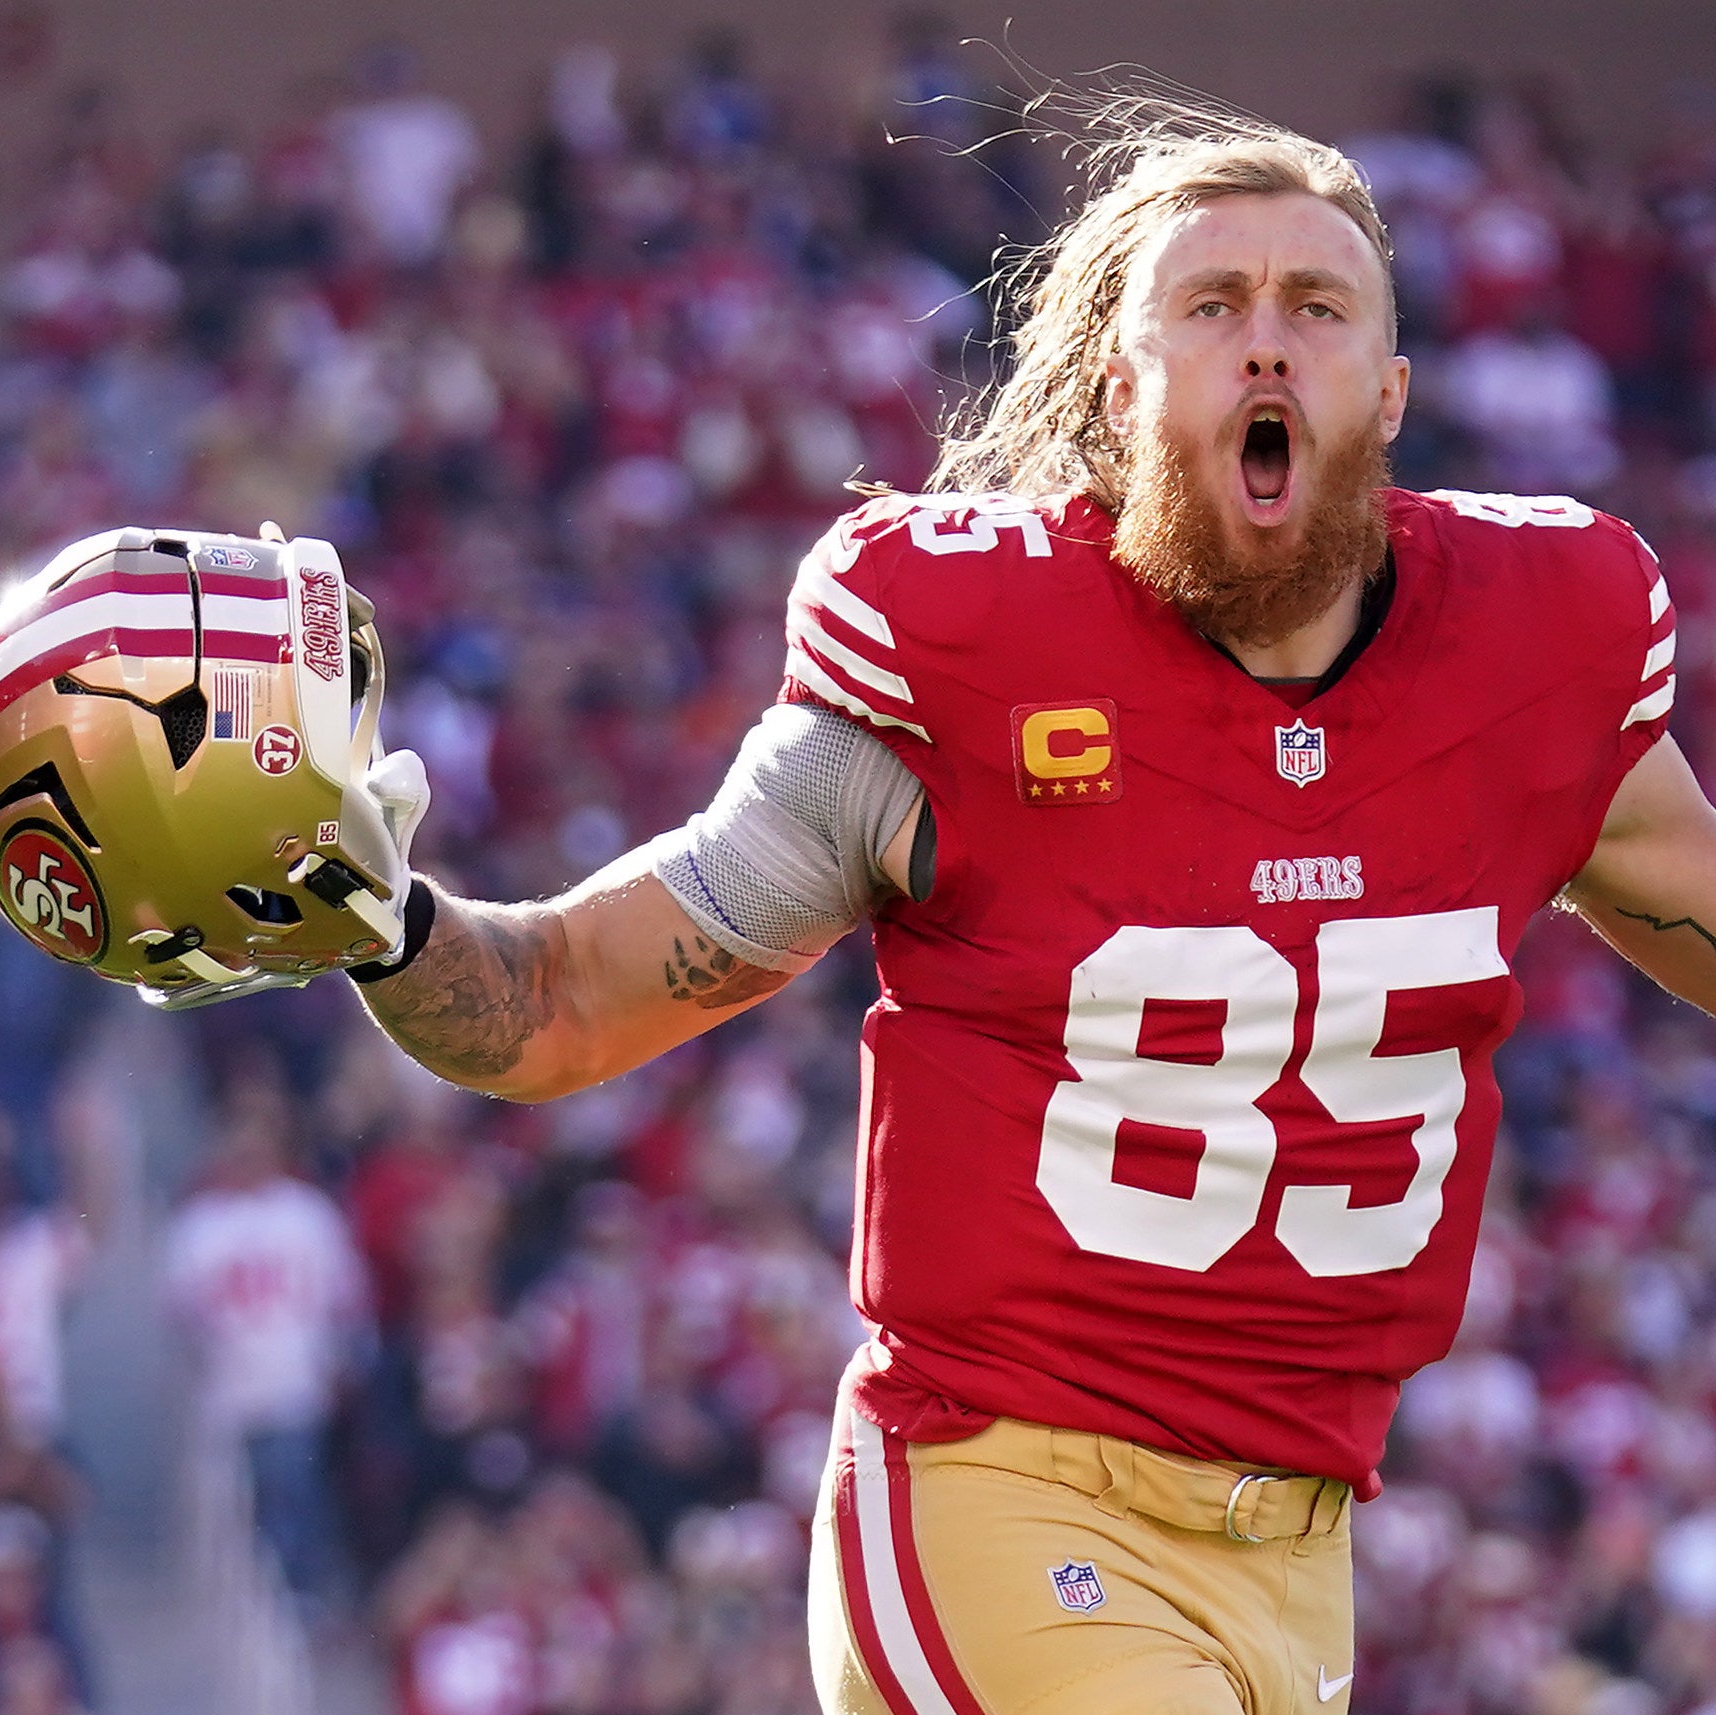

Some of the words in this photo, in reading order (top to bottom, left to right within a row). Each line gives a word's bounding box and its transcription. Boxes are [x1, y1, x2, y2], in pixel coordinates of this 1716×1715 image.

[299, 565, 344, 682] 49ERS
[262, 725, 296, 771] 37
[1021, 706, 1112, 780] C
[1282, 750, 1318, 774] NFL
[319, 823, 337, 842] 85
[7, 852, 95, 942] SF
[1248, 854, 1365, 904] 49ERS
[1035, 904, 1511, 1279] 85
[1062, 1582, 1099, 1605] NFL
